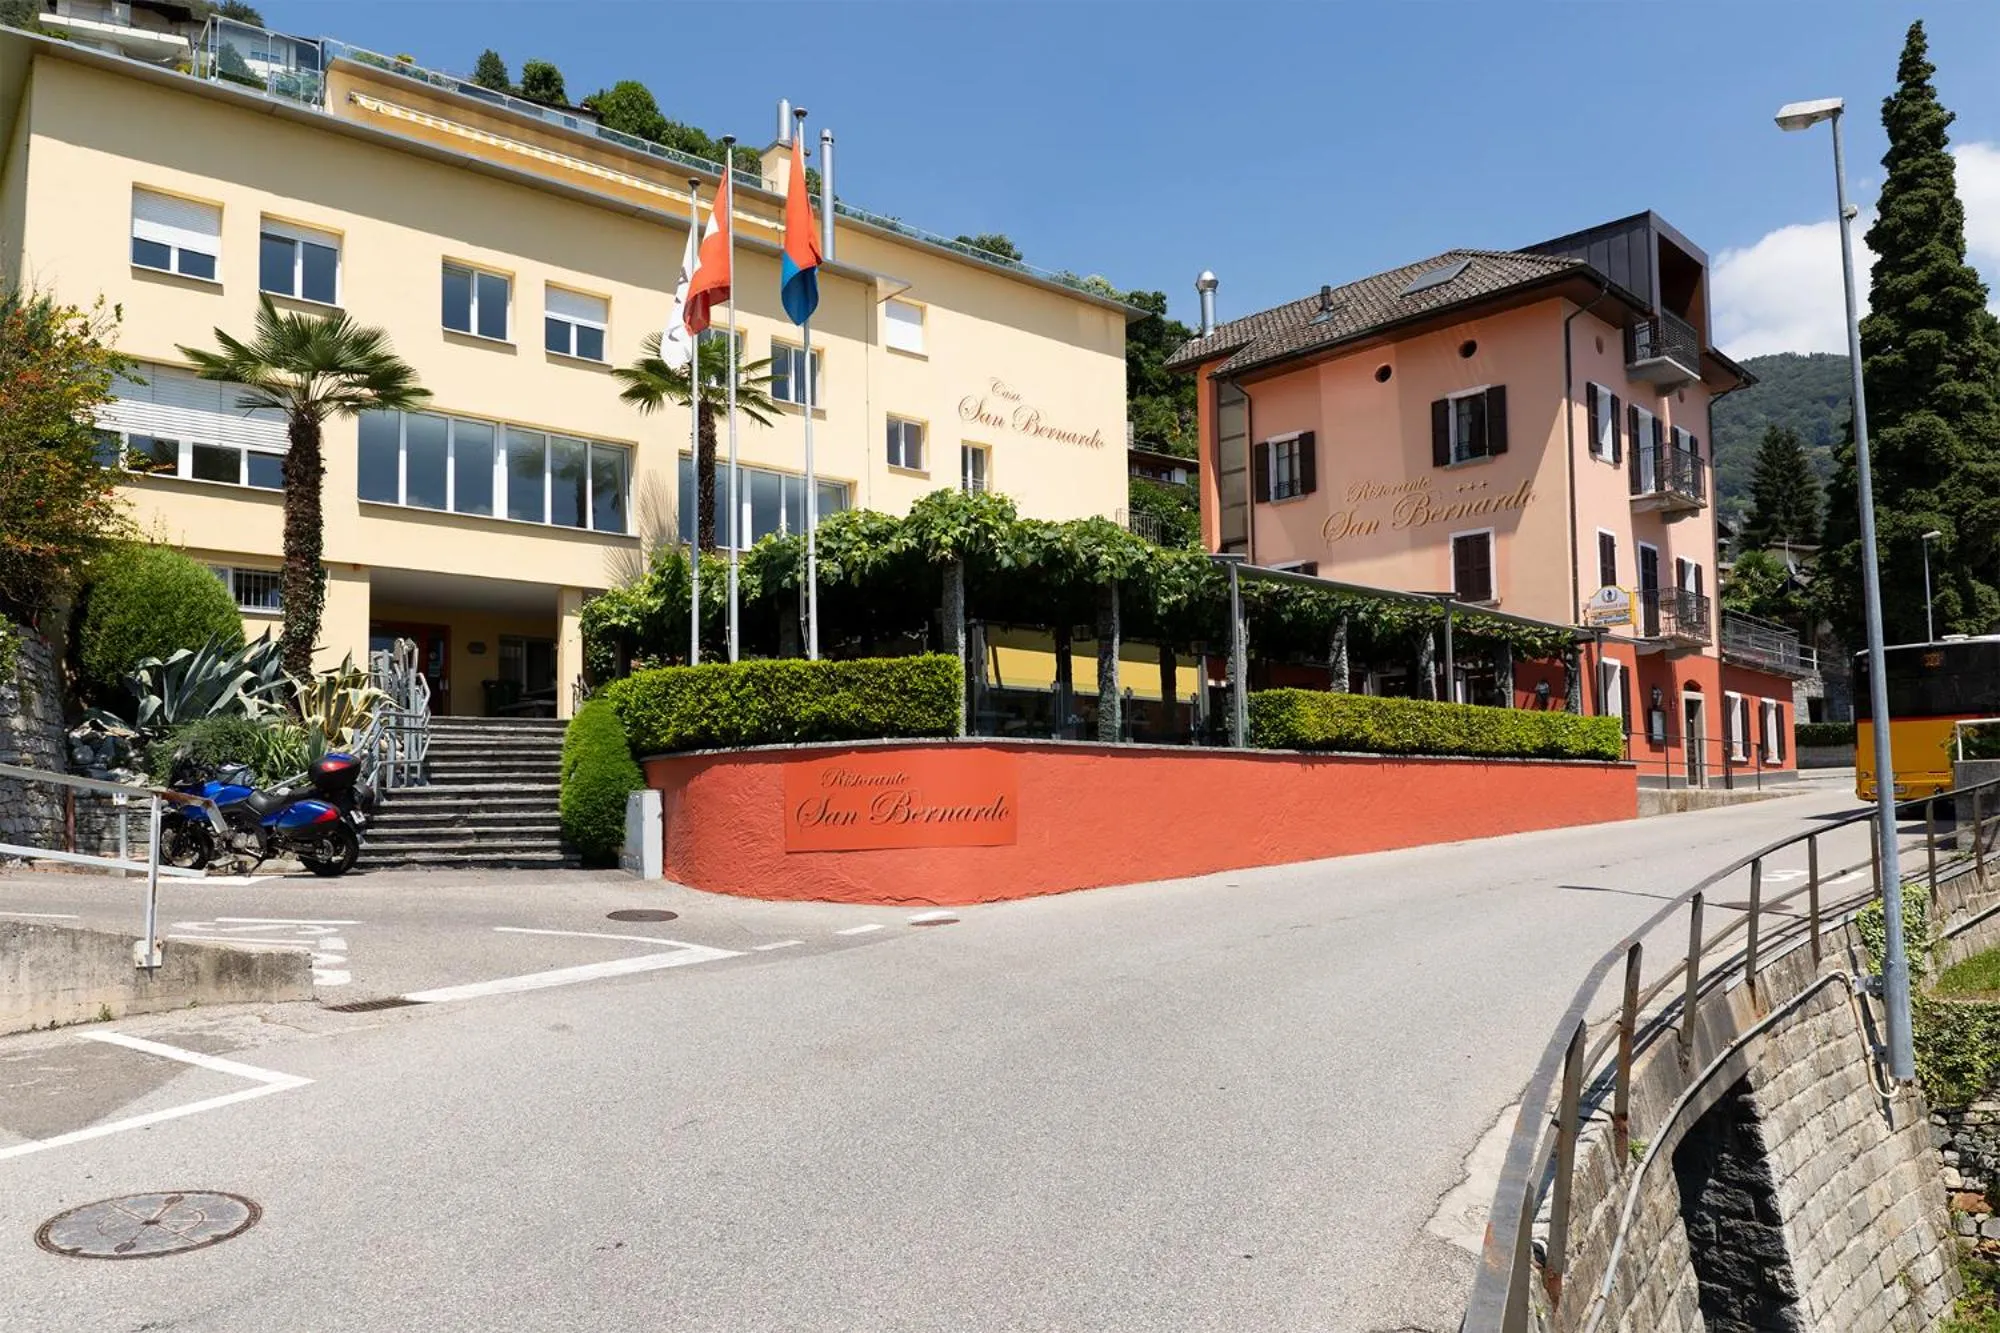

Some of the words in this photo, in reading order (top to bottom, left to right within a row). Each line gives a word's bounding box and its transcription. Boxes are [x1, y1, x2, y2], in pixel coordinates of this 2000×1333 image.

[958, 395, 1006, 427] San
[1011, 405, 1105, 449] Bernardo
[1347, 476, 1432, 502] Ristorante
[1321, 506, 1381, 544] San
[1391, 480, 1536, 528] Bernardo
[820, 767, 911, 788] Ristorante
[795, 797, 858, 828] San
[869, 789, 1010, 826] Bernardo
